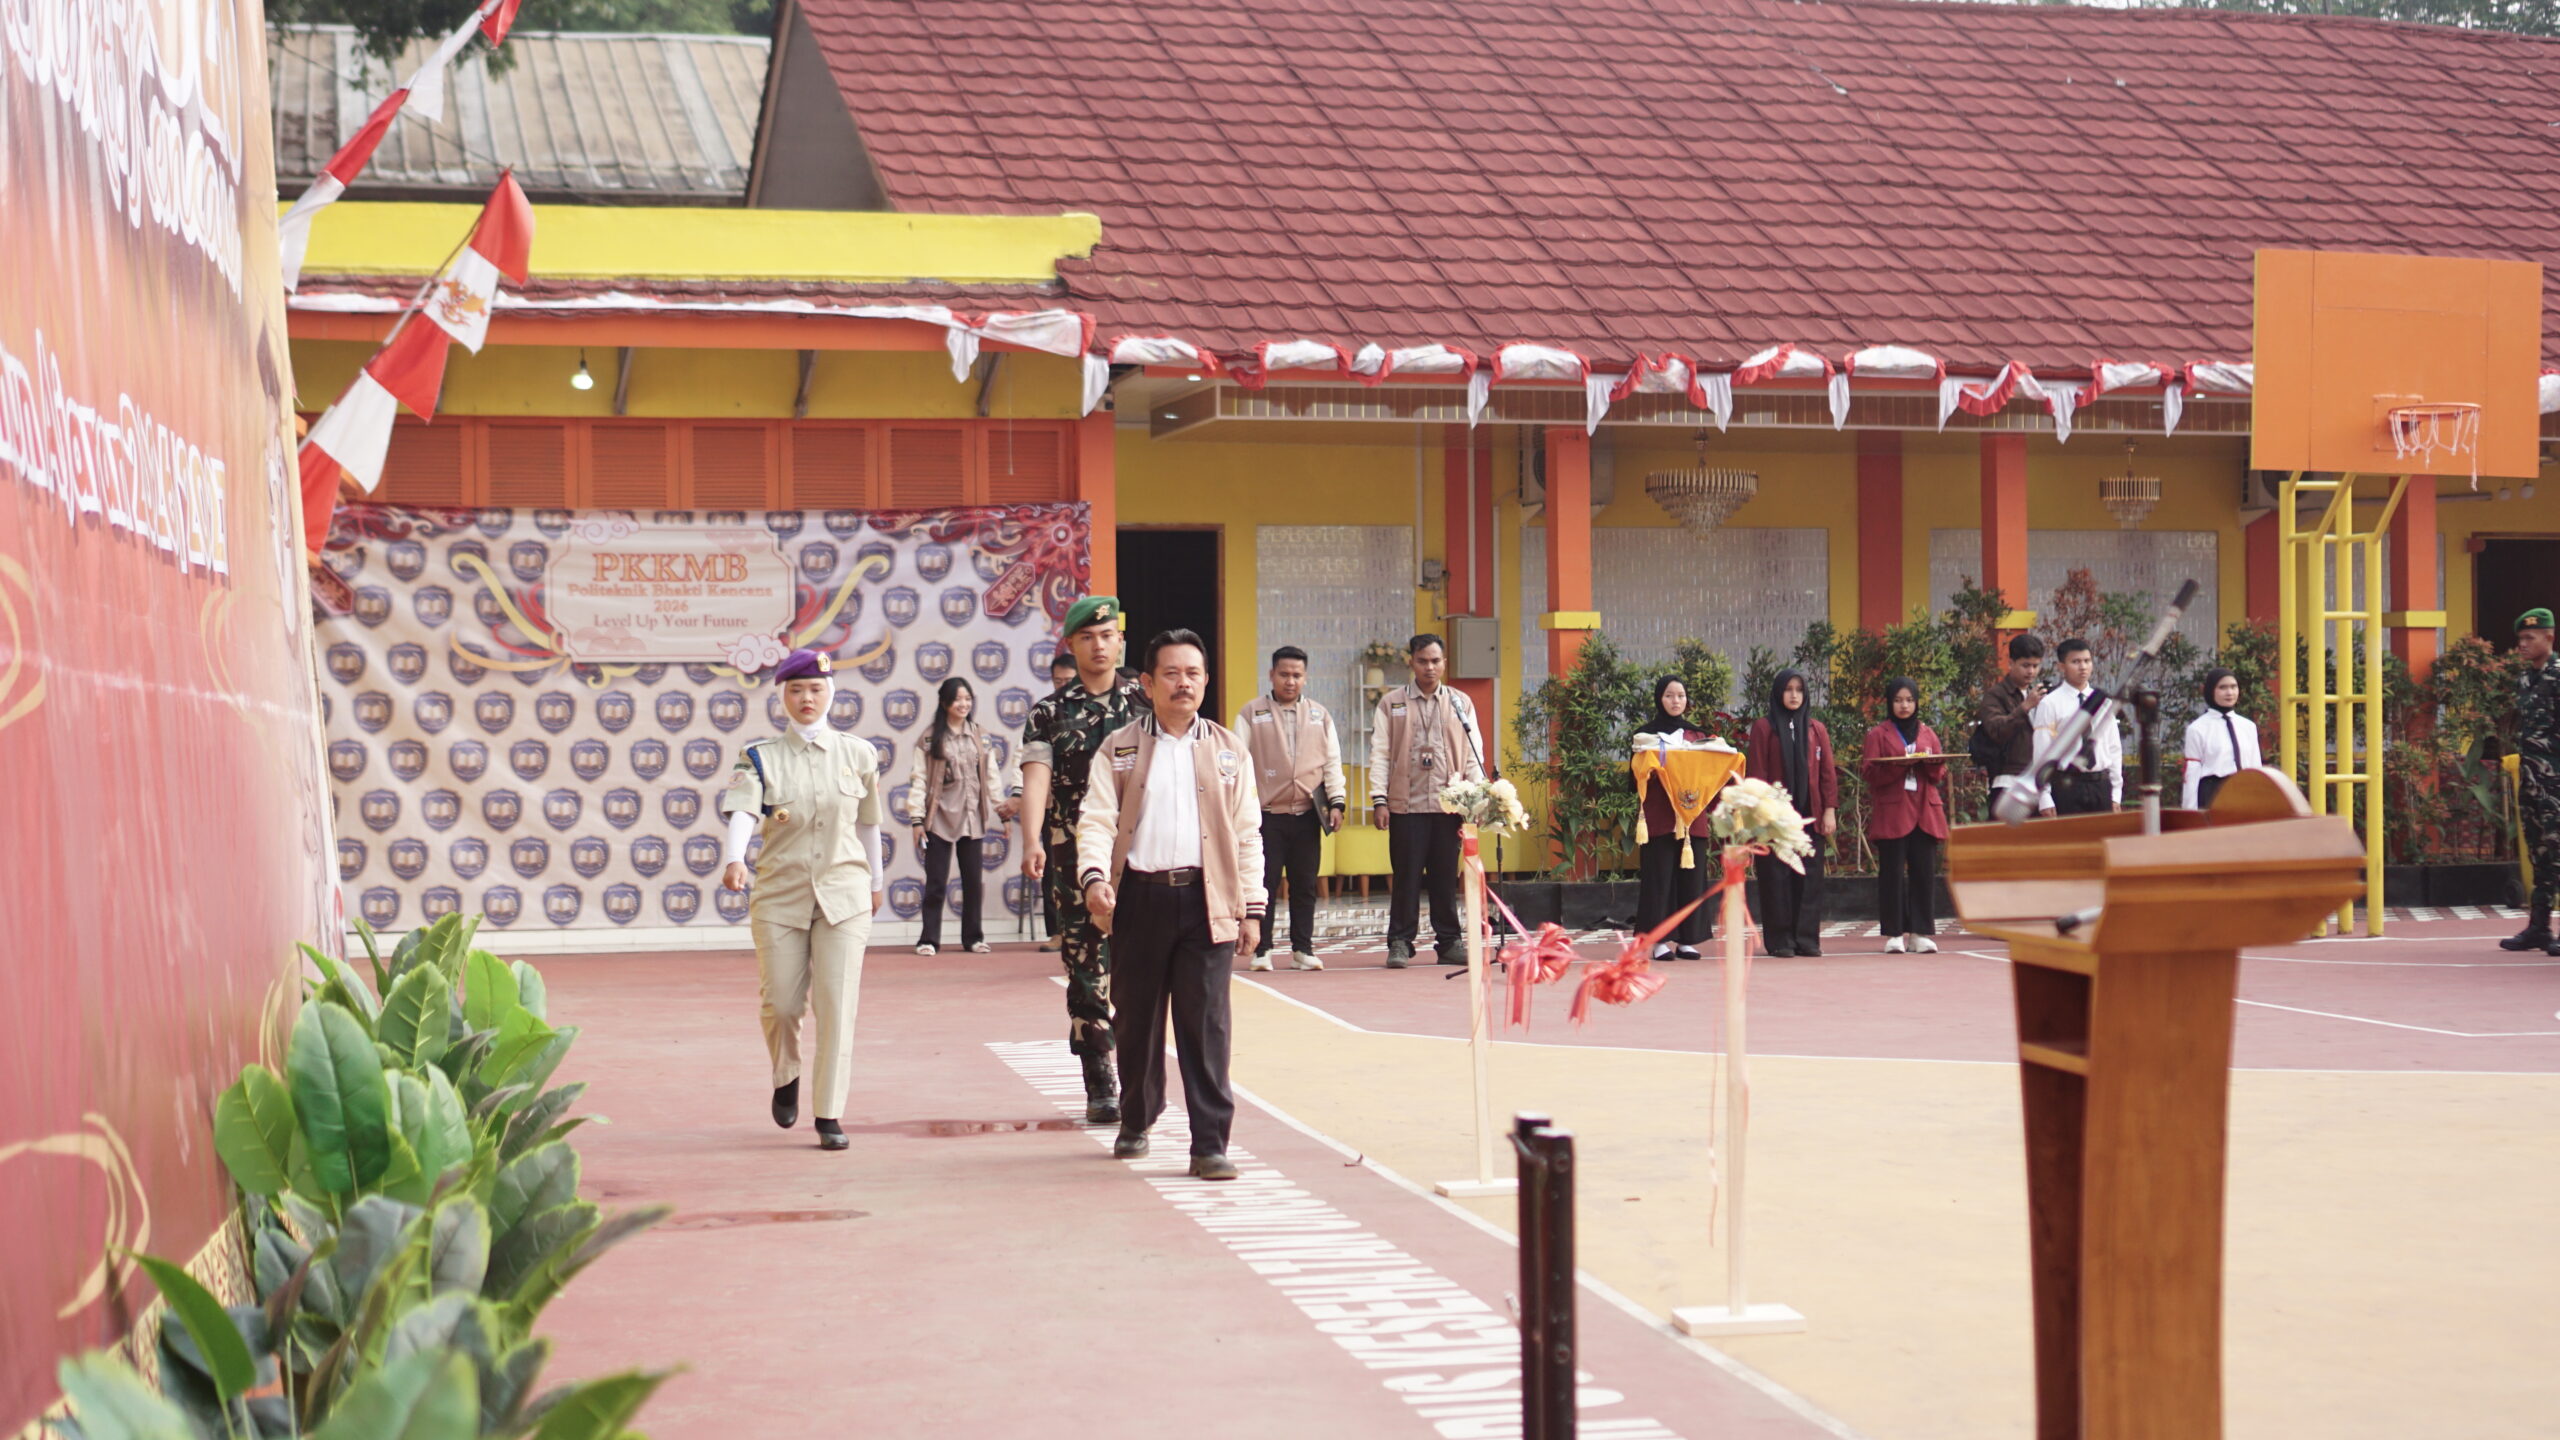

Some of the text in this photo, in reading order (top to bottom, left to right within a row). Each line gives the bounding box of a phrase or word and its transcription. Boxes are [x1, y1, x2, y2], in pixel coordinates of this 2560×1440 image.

[35, 327, 136, 530] Ajaran
[592, 553, 748, 582] PKKMB
[567, 583, 773, 597] Politeknik Bhakti Kencana
[654, 600, 689, 613] 2026
[594, 614, 748, 630] Level Up Your Future
[1218, 1232, 1522, 1370] KESEHATAN
